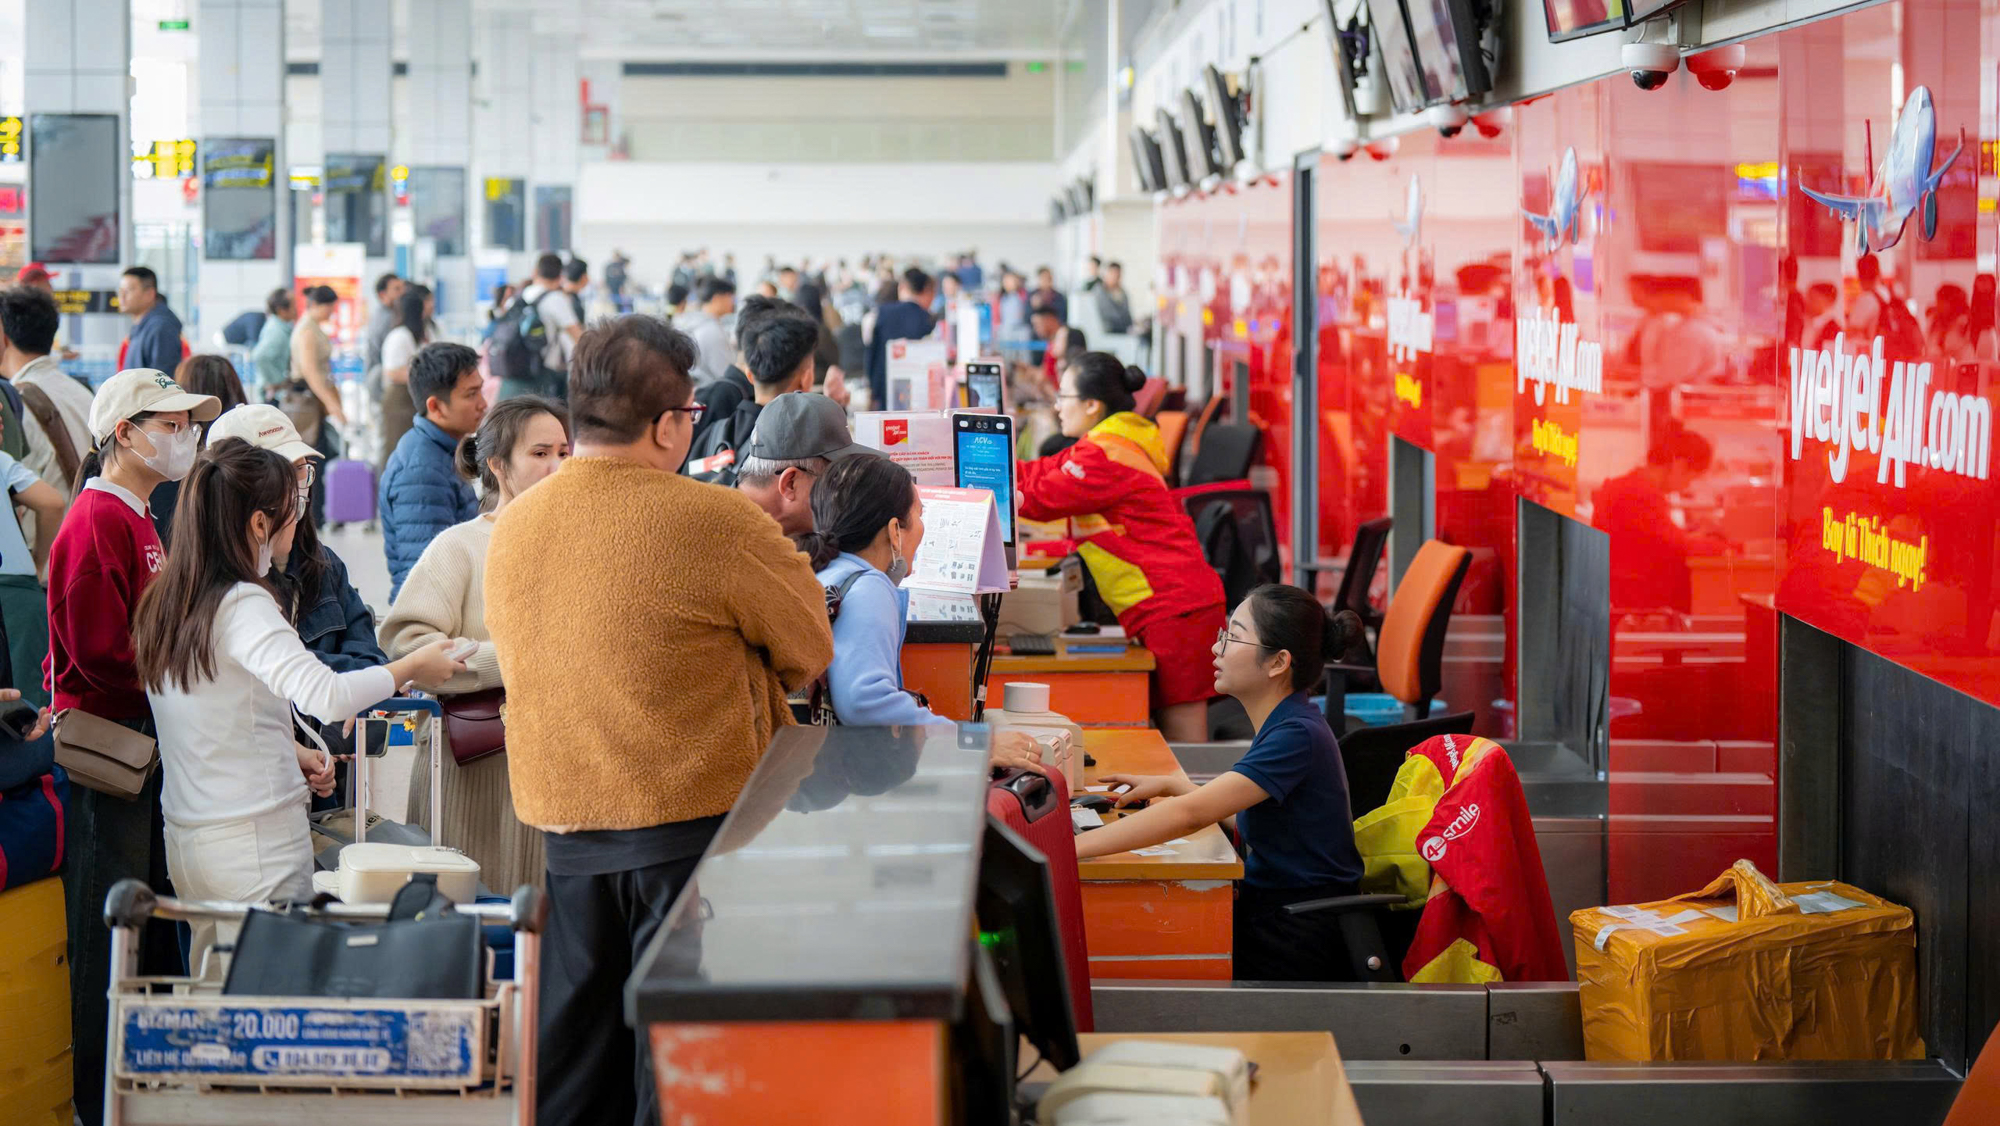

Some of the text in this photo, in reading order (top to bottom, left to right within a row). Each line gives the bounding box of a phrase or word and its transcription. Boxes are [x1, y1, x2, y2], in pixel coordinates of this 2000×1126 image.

[1823, 507, 1845, 564] Bay
[1858, 516, 1889, 571] Thích
[1891, 535, 1927, 592] ngay!
[1443, 803, 1480, 838] smile
[233, 1012, 299, 1039] 20.000
